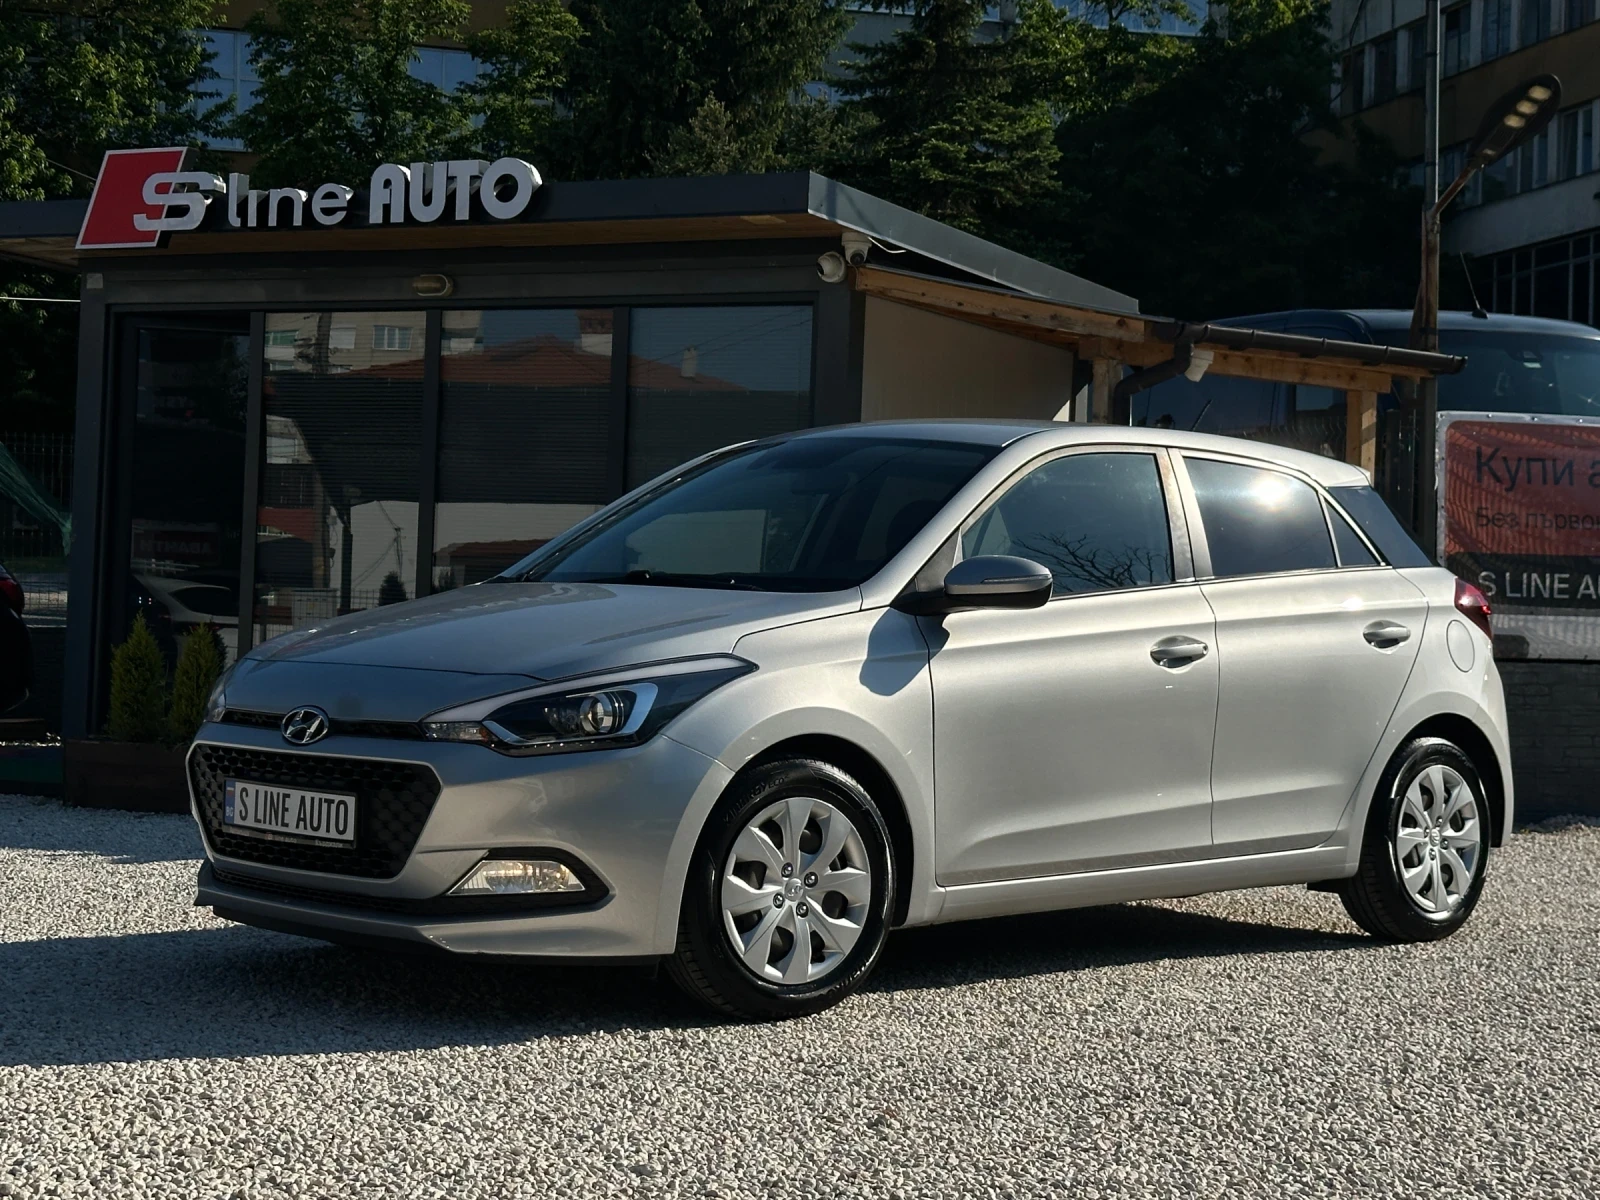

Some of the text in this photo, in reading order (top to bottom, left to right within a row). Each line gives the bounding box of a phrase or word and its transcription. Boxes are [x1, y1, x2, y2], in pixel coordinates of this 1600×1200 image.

[133, 157, 538, 230] S line AUTO
[1476, 446, 1574, 492] Купи
[1477, 506, 1600, 533] Без първо
[1478, 571, 1600, 599] S LINE A
[225, 806, 234, 817] BG
[239, 787, 349, 835] S LINE AUTO
